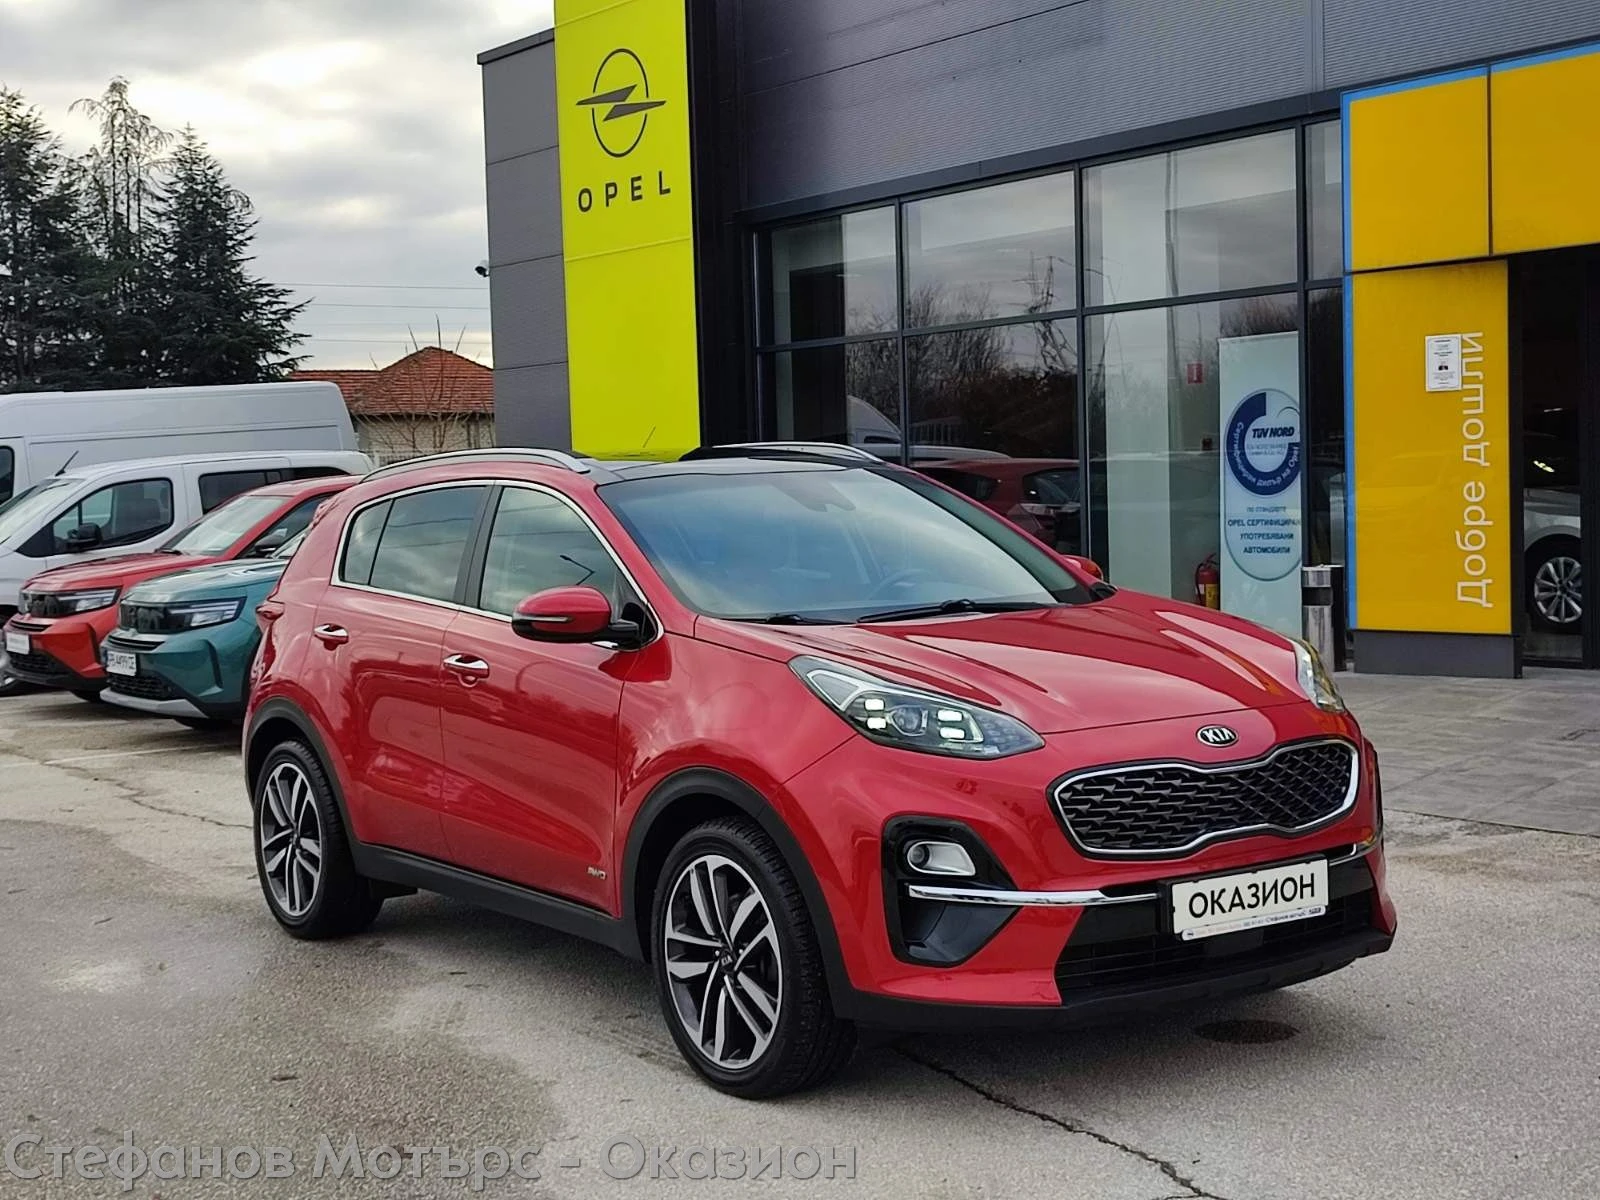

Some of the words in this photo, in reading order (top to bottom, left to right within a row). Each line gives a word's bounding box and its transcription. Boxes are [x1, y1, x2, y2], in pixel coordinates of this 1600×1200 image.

[578, 171, 671, 212] OPEL
[1461, 332, 1490, 466] дошли
[1269, 426, 1295, 438] NORD
[1227, 519, 1246, 527] OPEL
[1243, 546, 1291, 554] АВТОМОБИЛИ
[1457, 480, 1494, 608] Добре
[1202, 727, 1236, 743] KIA
[1188, 872, 1316, 919] ОКАЗИОН
